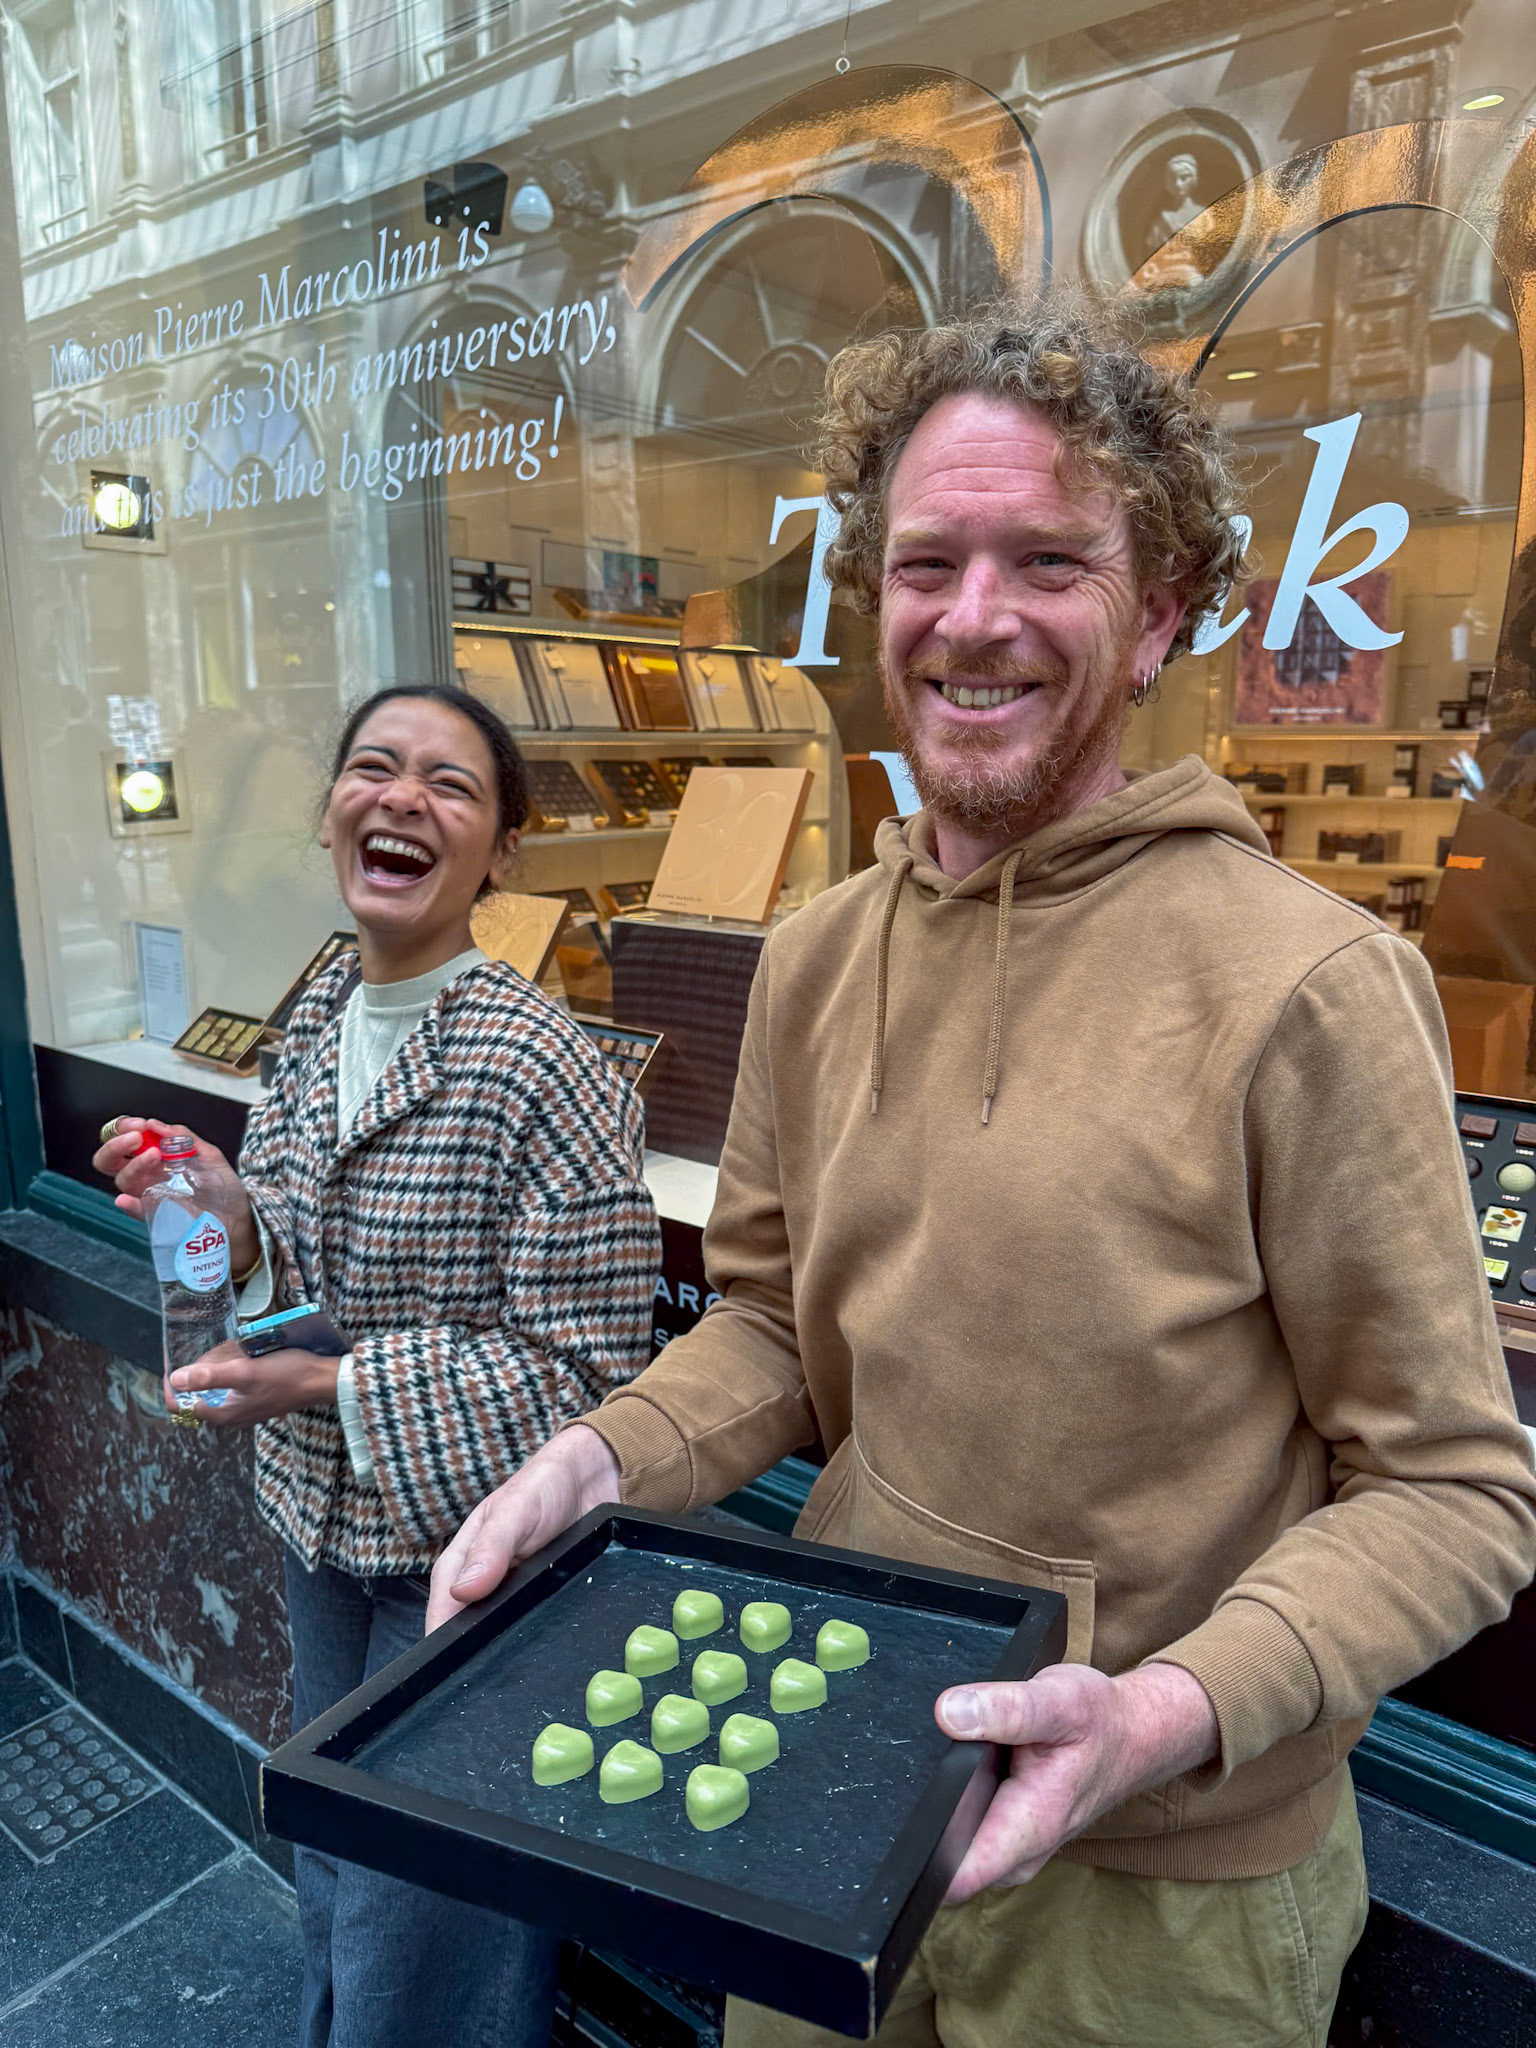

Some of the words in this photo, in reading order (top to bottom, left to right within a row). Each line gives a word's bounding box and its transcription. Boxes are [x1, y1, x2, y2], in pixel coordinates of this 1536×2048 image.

[49, 328, 145, 390] Maison
[154, 299, 244, 360] Pierre
[257, 215, 441, 331] Marcolini
[457, 206, 491, 272] is
[54, 393, 201, 465] celebrating
[210, 379, 246, 430] its
[256, 344, 336, 419] 30th
[350, 296, 617, 399] anniversary,
[172, 475, 195, 519] is
[205, 456, 262, 529] just
[274, 442, 326, 503] the
[340, 395, 564, 501] beginning!
[185, 1232, 225, 1255] SPA
[192, 1257, 224, 1272] INTENSE
